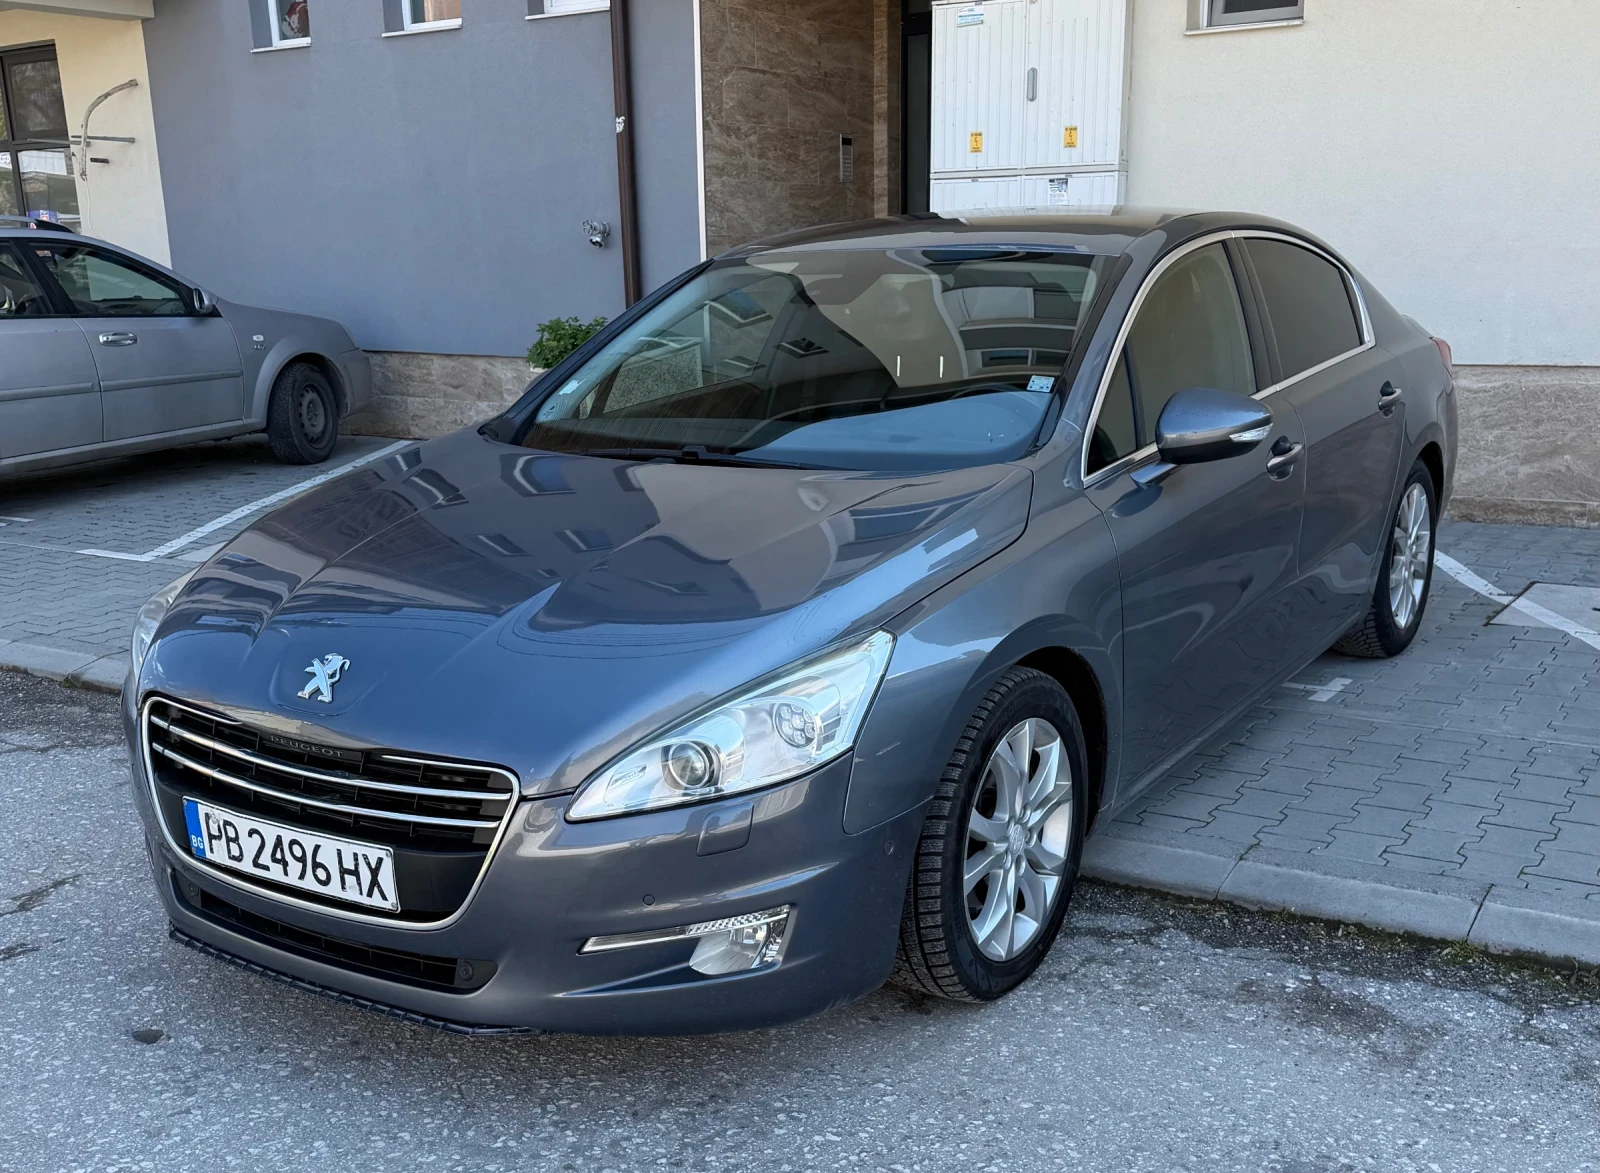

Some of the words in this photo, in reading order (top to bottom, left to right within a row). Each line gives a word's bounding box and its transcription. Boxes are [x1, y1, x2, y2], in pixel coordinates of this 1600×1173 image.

[270, 735, 344, 758] PEUGEOT
[190, 835, 204, 849] BG
[204, 811, 244, 863] PB
[247, 828, 332, 887] 2496
[336, 848, 389, 902] HX
